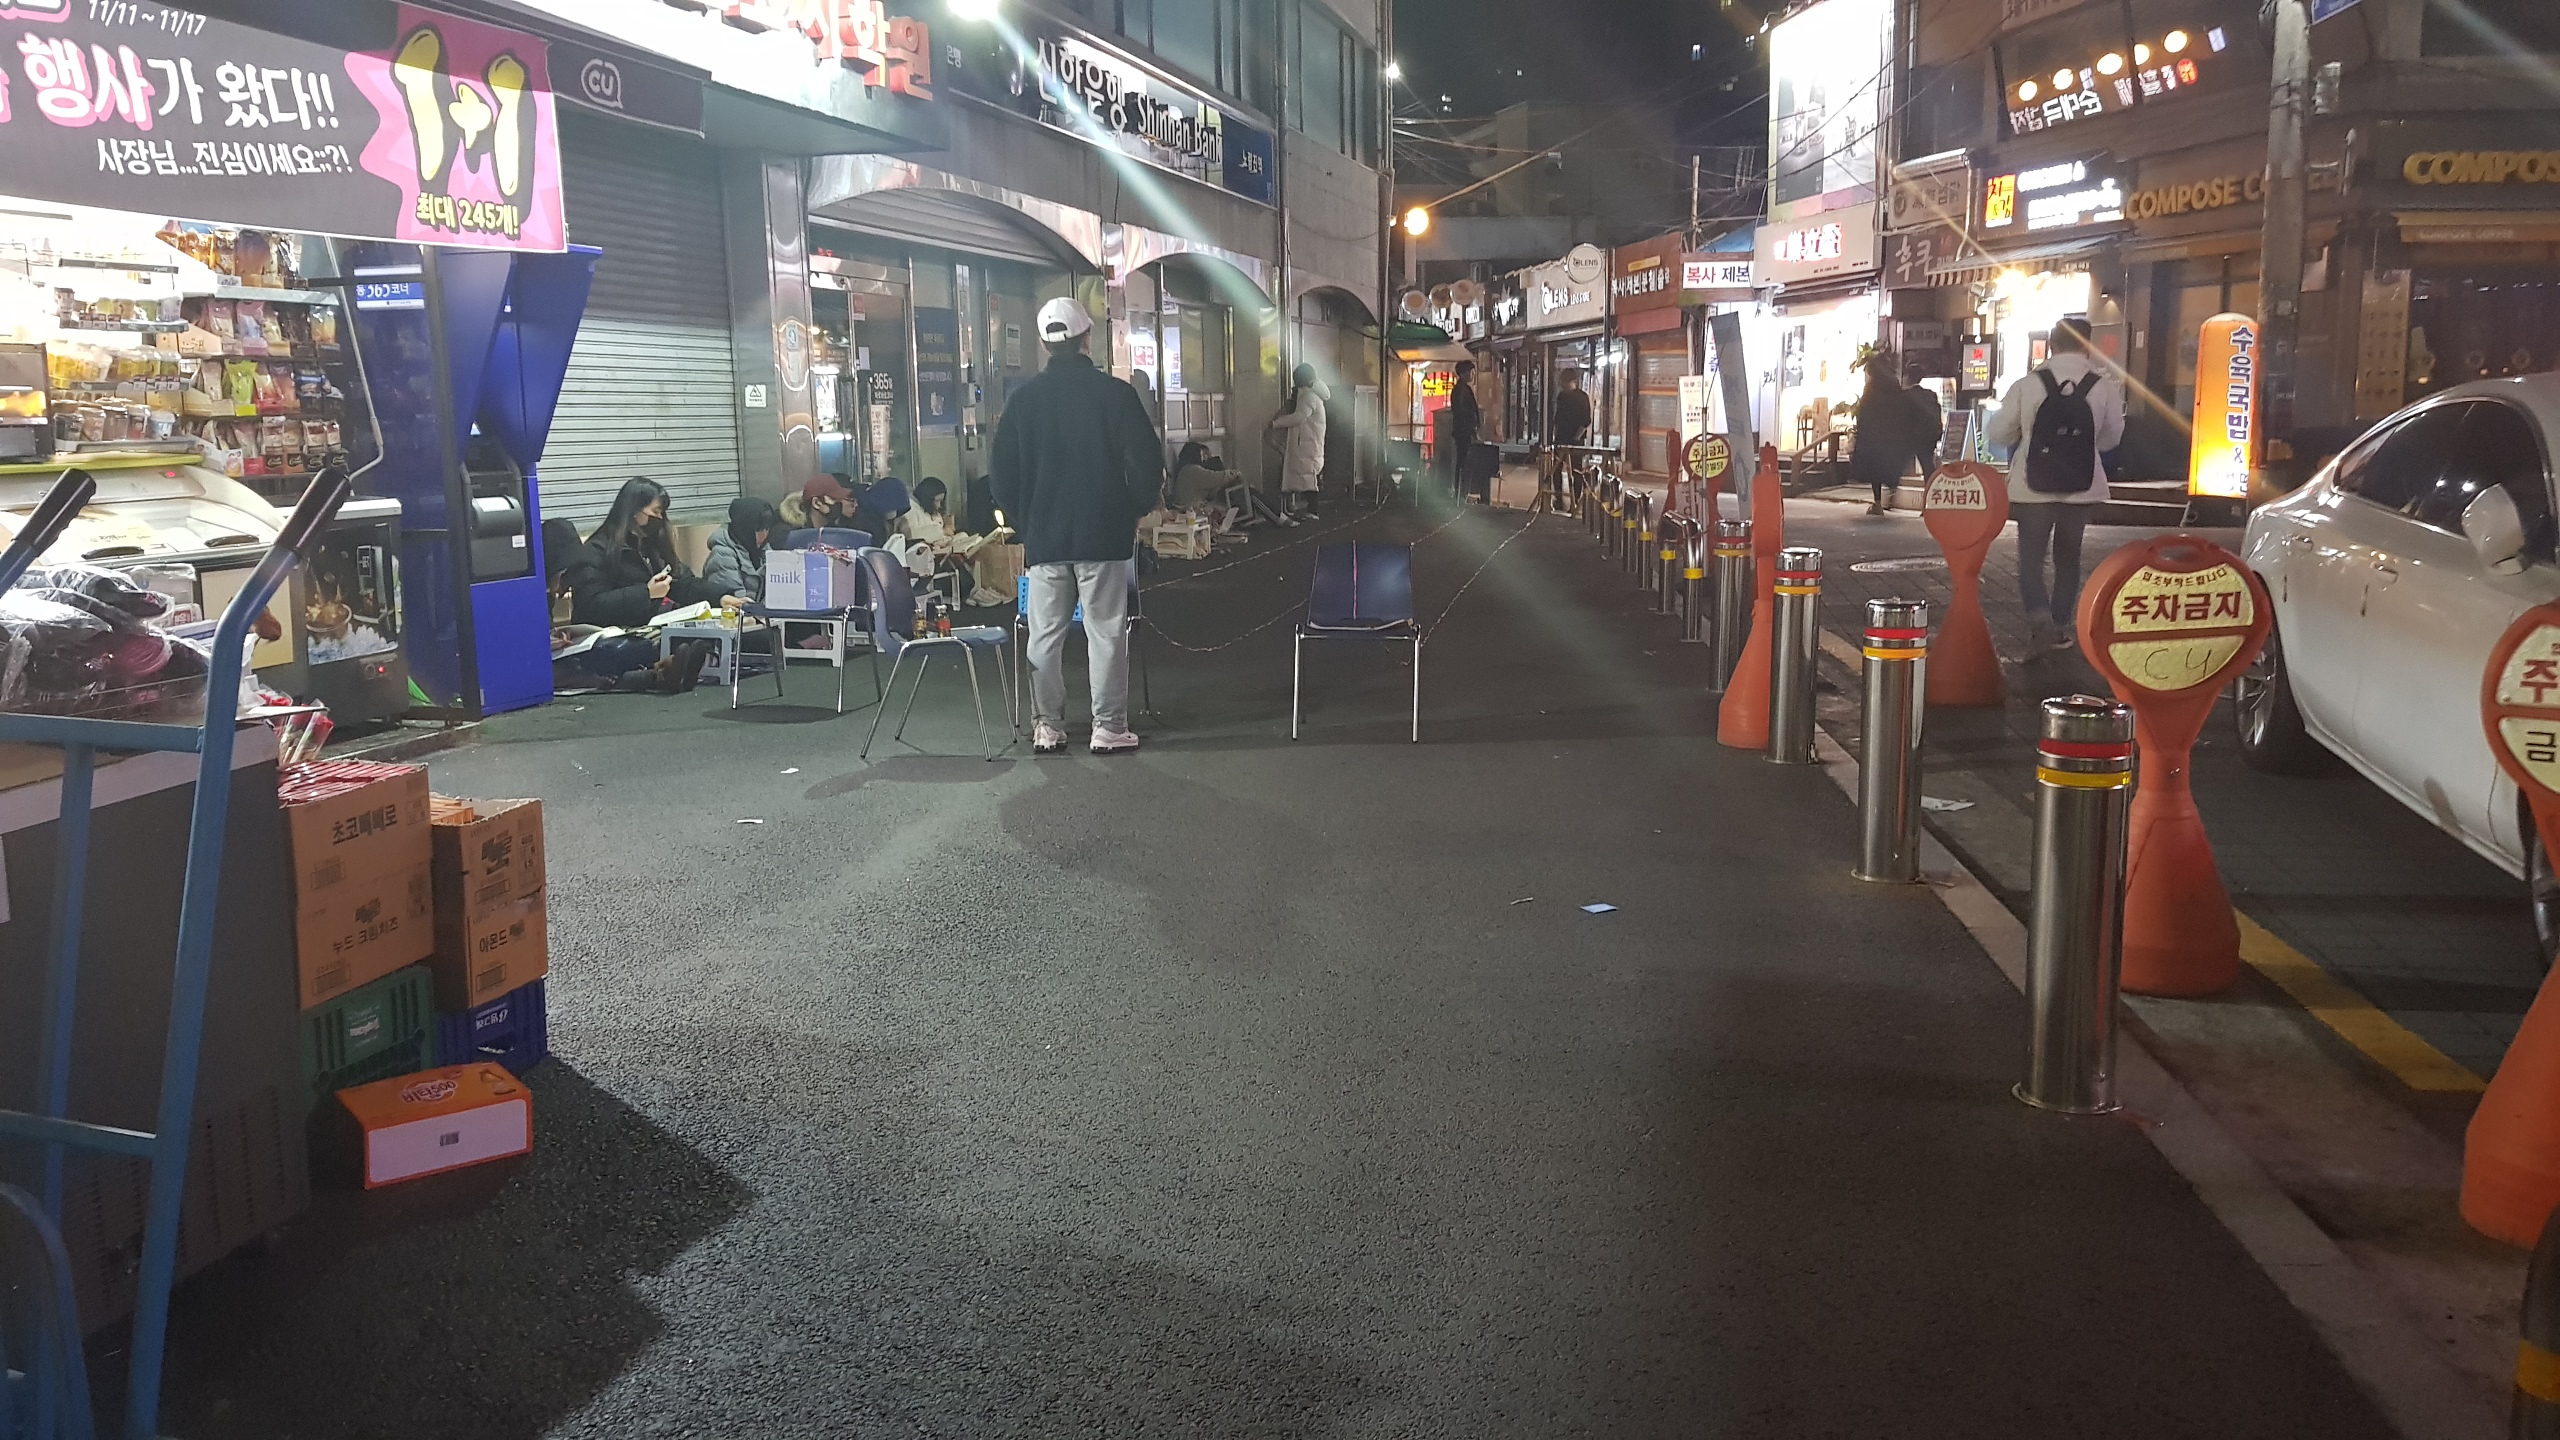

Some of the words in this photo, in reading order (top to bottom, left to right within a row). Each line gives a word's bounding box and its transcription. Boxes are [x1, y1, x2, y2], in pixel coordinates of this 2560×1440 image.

[88, 0, 138, 27] 11/11
[160, 9, 207, 37] 11/17
[16, 31, 204, 130] 행사가
[215, 61, 339, 131] 왔다!!
[588, 69, 615, 97] CU
[1036, 37, 1128, 133] 신한은행
[1137, 92, 1191, 152] Shinhan
[1194, 115, 1224, 165] Bank
[416, 192, 456, 229] 최대
[458, 198, 520, 237] 245개!
[2126, 176, 2240, 220] COMPOSE
[1687, 266, 1716, 284] 복사
[1721, 266, 1749, 283] 제본
[2228, 326, 2254, 441] 수육국밥
[1692, 445, 1725, 459] 주금지
[1931, 488, 1981, 506] 주차금지
[770, 571, 802, 585] miilk
[2121, 591, 2243, 625] 주차금지
[479, 928, 508, 953] 아몬드
